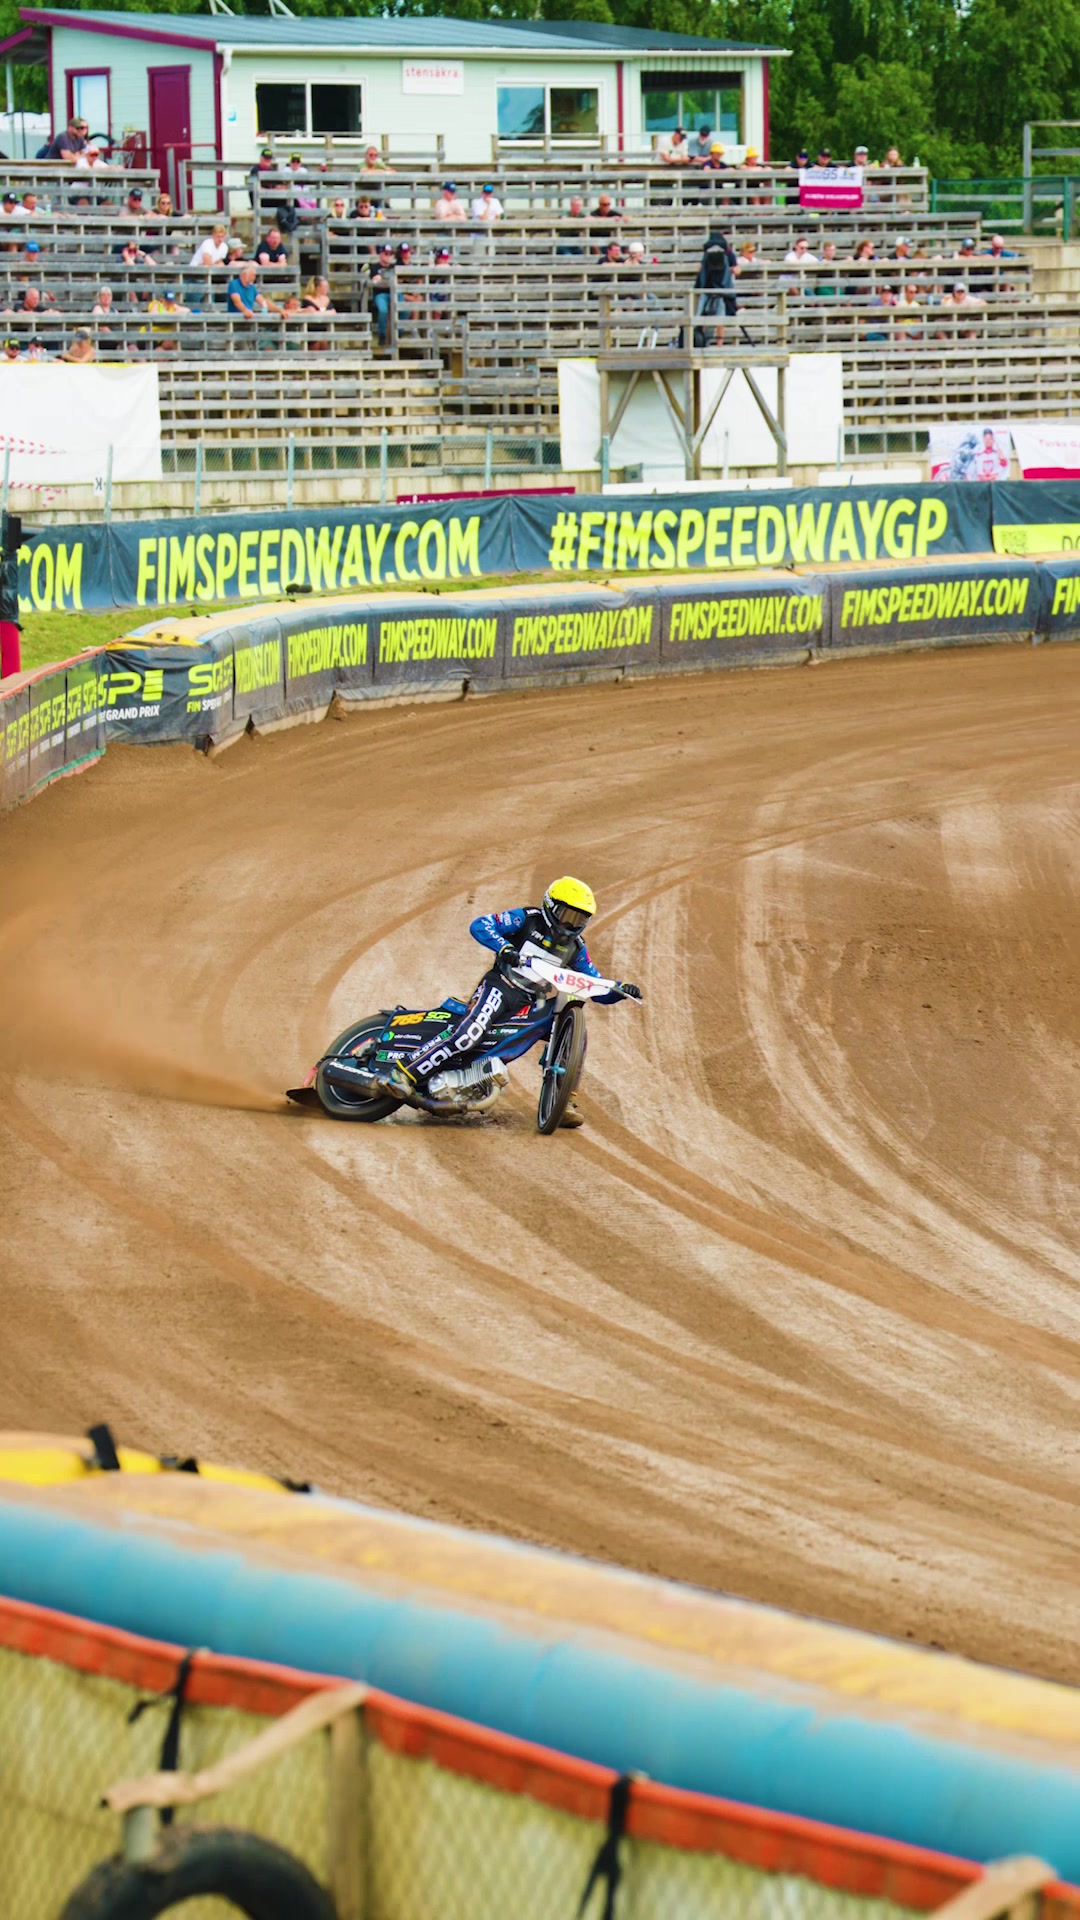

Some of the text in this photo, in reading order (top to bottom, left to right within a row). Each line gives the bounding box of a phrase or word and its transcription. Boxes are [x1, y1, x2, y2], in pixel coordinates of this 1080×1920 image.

[549, 498, 947, 570] #FIMSPEEDWAYGP
[137, 516, 482, 607] FIMSPEEDWAY.COM
[669, 594, 824, 643] FIMSPEEDWAY.COM
[841, 578, 1030, 628] FIMSPEEDWAY.COM
[379, 618, 498, 664] FIMSPEEDWAY.COM
[512, 605, 653, 658] FIMSPEEDWAY.COM
[106, 705, 161, 721] GRAND PRIX
[566, 974, 594, 992] BST
